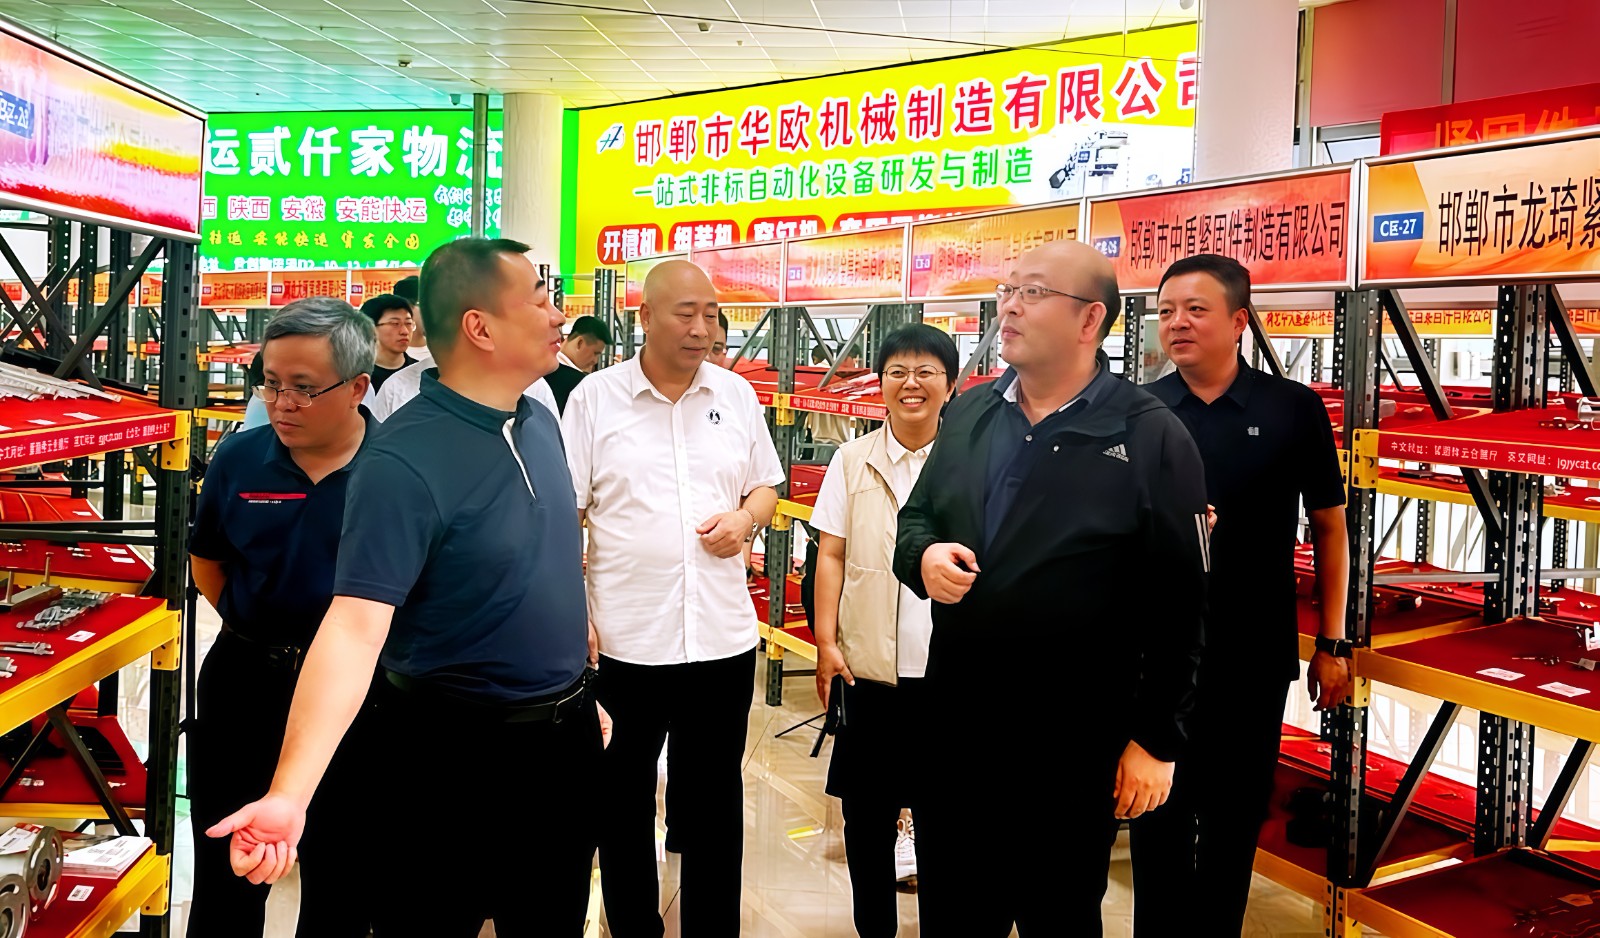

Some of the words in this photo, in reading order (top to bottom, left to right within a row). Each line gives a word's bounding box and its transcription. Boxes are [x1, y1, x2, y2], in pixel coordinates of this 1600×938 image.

[635, 147, 1032, 206] 一站式非标自动化设备研发与制造
[229, 198, 270, 220] 陕西
[283, 198, 325, 221] 安徽
[338, 198, 427, 222] 安能快运
[1131, 202, 1346, 269] 邯郸市中盾紧固件制造有限公司
[1438, 176, 1600, 257] 邯郸市龙琦紧
